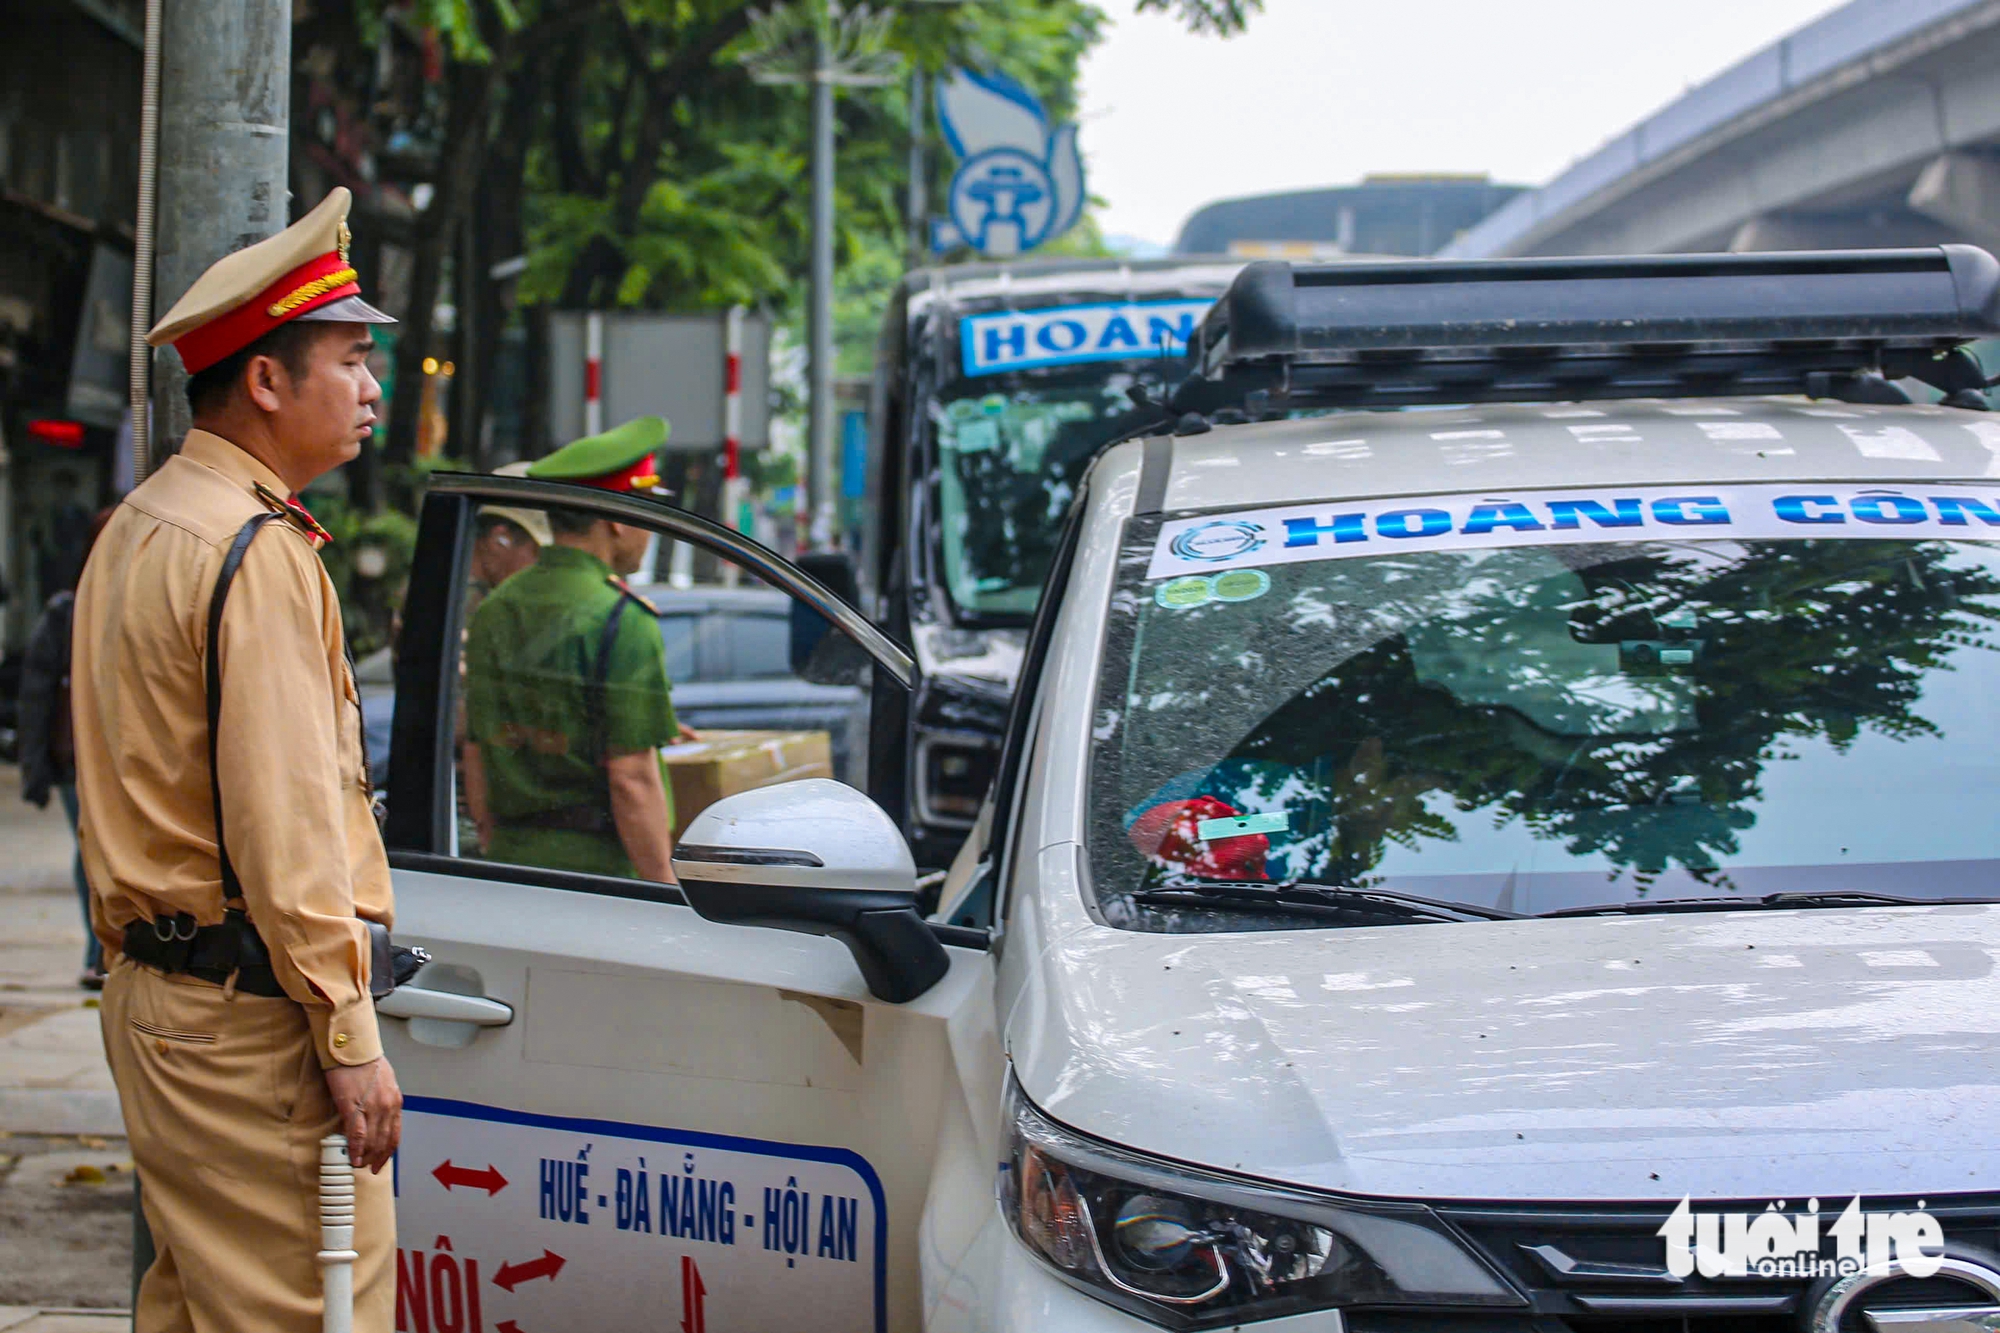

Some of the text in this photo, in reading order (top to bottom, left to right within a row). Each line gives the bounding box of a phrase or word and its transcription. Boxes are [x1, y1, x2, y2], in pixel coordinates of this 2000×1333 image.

[1283, 496, 1732, 548] HOÀNG
[540, 1143, 593, 1225] HUẾ
[616, 1157, 652, 1233] ĐÀ
[763, 1176, 810, 1269] HỘI
[817, 1195, 858, 1263] AN
